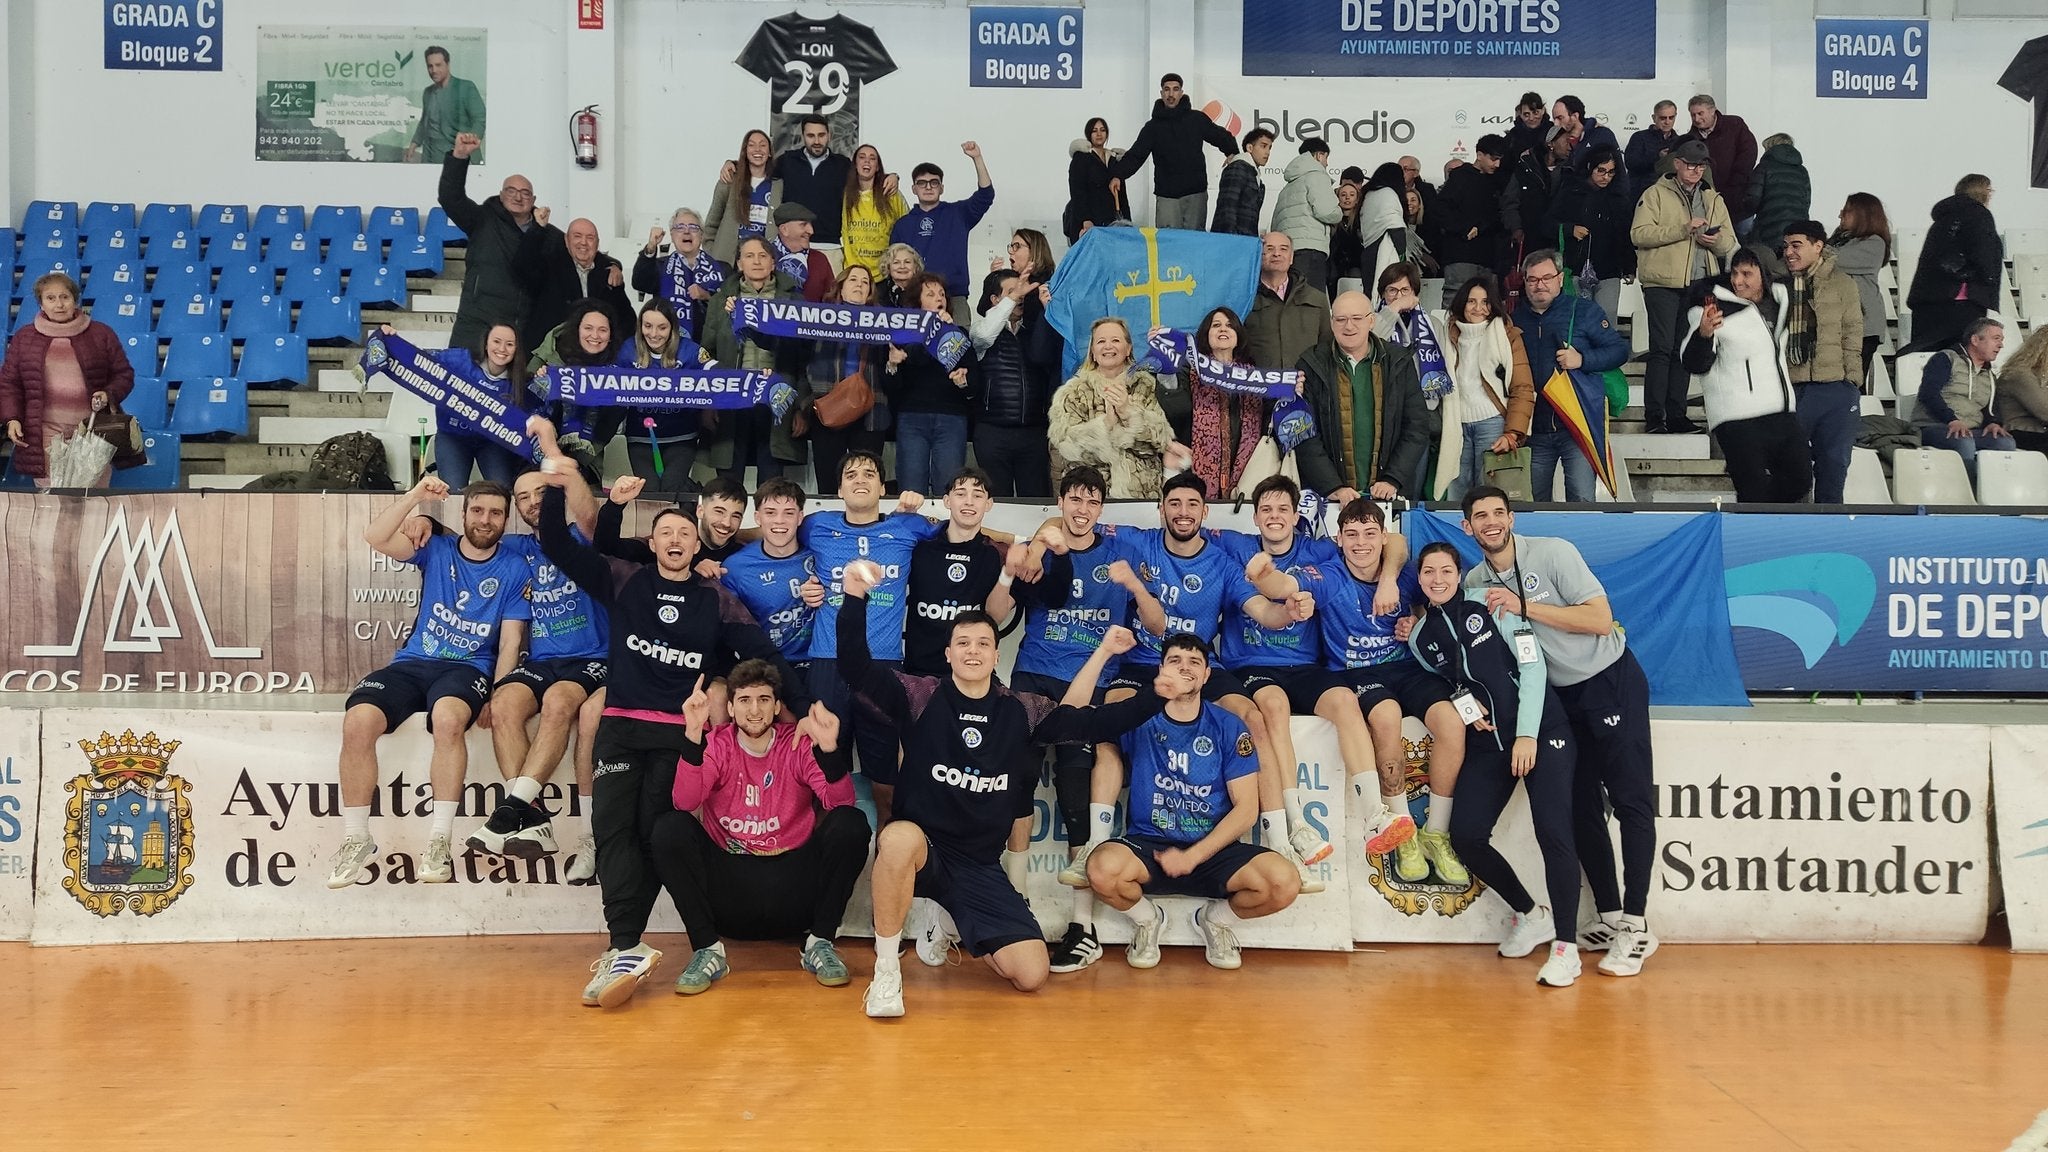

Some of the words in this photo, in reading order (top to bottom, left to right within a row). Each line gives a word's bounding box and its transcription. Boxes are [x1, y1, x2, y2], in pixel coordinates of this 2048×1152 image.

[113, 3, 189, 27] GRADA
[196, 0, 216, 29] C
[1341, 0, 1383, 32] DE
[1393, 0, 1561, 34] DEPORTES
[978, 22, 1051, 46] GRADA
[1057, 15, 1077, 46] C
[1824, 34, 1897, 57] GRADA
[1903, 26, 1922, 57] C
[121, 40, 189, 67] Bloque
[196, 35, 213, 63] 2
[801, 43, 834, 57] LON
[1340, 40, 1450, 55] AYUNTAMIENTO
[1454, 41, 1472, 55] DE
[1476, 41, 1561, 56] SANTANDER
[324, 60, 396, 78] verde
[986, 58, 1051, 84] Bloque
[1057, 52, 1073, 81] 3
[1831, 69, 1897, 95] Bloque
[1901, 64, 1918, 91] 4
[270, 93, 291, 107] 24
[782, 60, 850, 115] 29
[1253, 109, 1416, 144] blendio
[259, 136, 278, 145] 942
[281, 136, 301, 145] 940
[303, 137, 322, 145] 202
[745, 298, 759, 329] 1993
[797, 327, 844, 338] BALONMANO
[845, 332, 864, 340] BASE
[865, 333, 891, 341] OVIEDO
[413, 352, 447, 380] UNIÓN
[446, 373, 507, 416] FINANCIERA
[558, 367, 576, 401] 1993
[616, 396, 664, 404] BALONMANO
[665, 396, 684, 404] BASE
[685, 397, 713, 405] OVIEDO
[447, 394, 479, 421] Base
[481, 415, 524, 447] Oviedo
[857, 536, 869, 556] 9
[945, 553, 971, 562] LEGEA
[1888, 556, 2027, 585] INSTITUTO
[455, 590, 470, 611] 2
[657, 593, 686, 603] LEGEA
[789, 578, 801, 599] 6
[1072, 578, 1084, 599] 3
[1161, 583, 1180, 606] 29
[1888, 593, 1944, 638] DE
[354, 620, 381, 640] C/
[435, 625, 480, 652] OVIEDO
[1888, 649, 2034, 669] AYUNTAMIENTO
[97, 673, 140, 692] DE
[155, 671, 316, 693] EUROPA
[958, 712, 989, 724] LEGEA
[1167, 749, 1189, 775] 34
[225, 837, 297, 888] de
[1660, 840, 1974, 895] Santander
